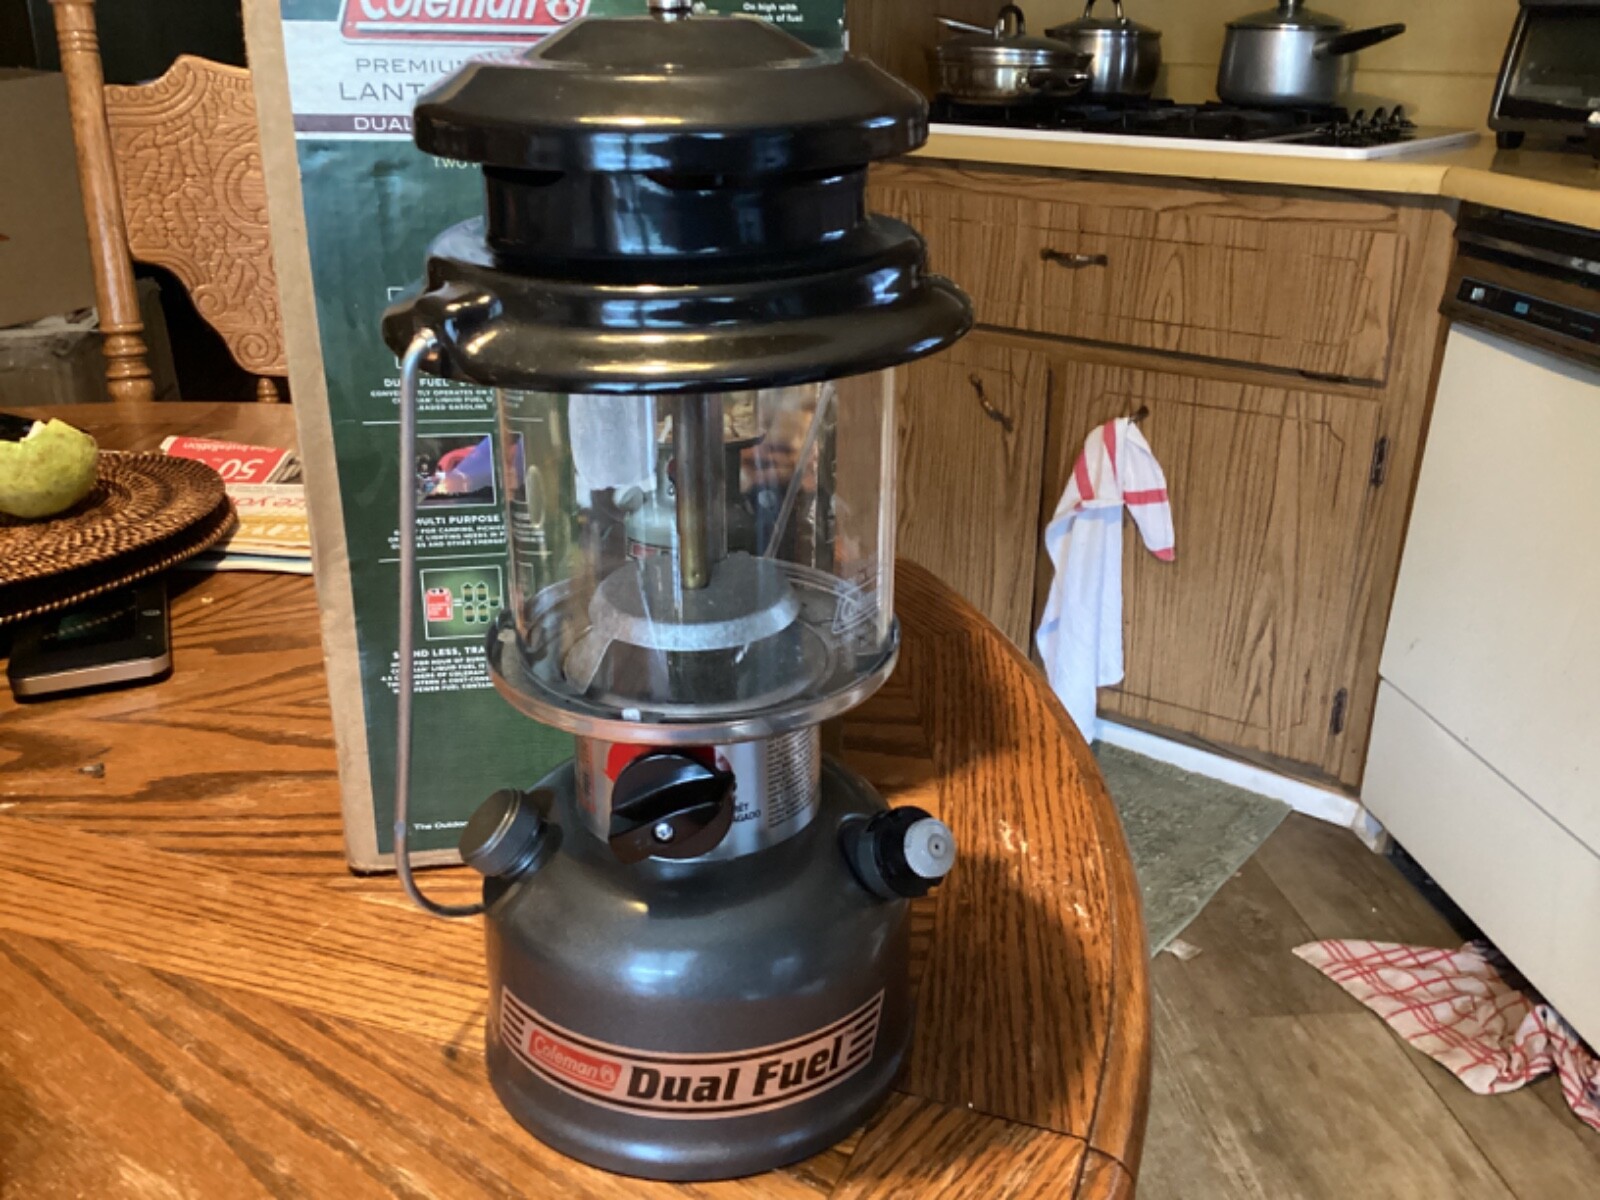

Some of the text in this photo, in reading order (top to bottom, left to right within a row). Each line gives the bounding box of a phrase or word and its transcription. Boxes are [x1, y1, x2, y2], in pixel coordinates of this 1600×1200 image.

[356, 58, 463, 74] PREMIU
[338, 81, 426, 101] LANT
[413, 823, 433, 831] The
[534, 1035, 843, 1103] Coleman Dual Fuel
